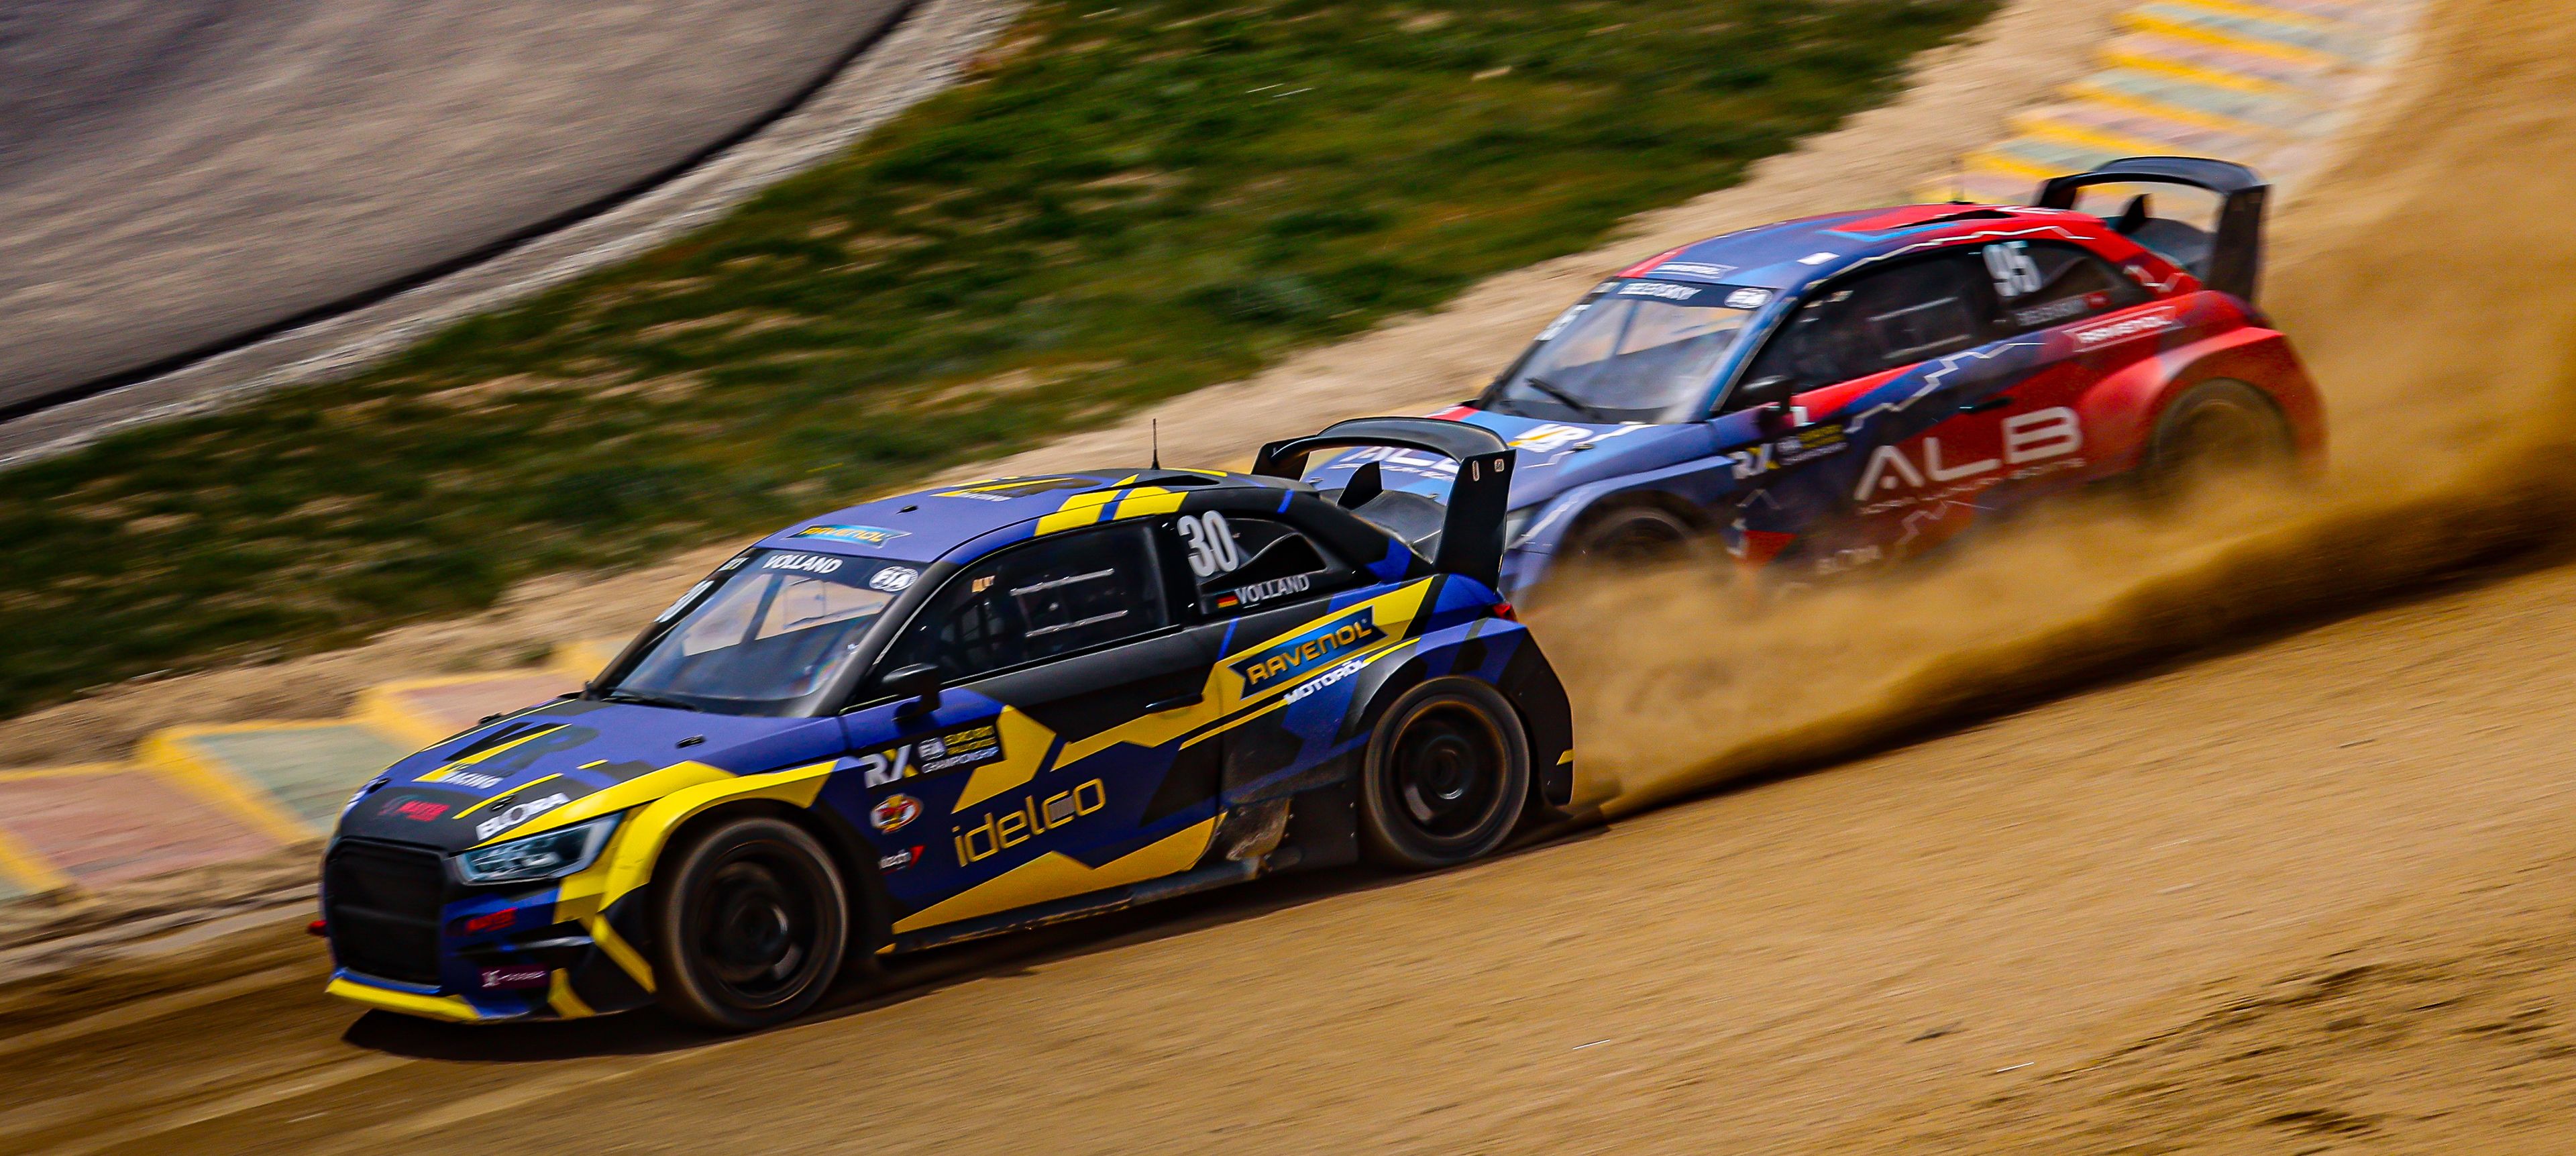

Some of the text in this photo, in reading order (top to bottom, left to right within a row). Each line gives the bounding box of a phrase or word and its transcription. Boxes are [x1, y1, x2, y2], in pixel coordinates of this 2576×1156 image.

[1982, 241, 2042, 297] 95
[1854, 407, 2082, 501] ALB
[761, 555, 843, 575] VOLLAND
[1177, 510, 1240, 577] 30
[1235, 574, 1310, 605] VOLLAND
[1246, 619, 1373, 686] RAVENOL
[859, 744, 919, 788] RX
[951, 778, 1106, 868] idelco
